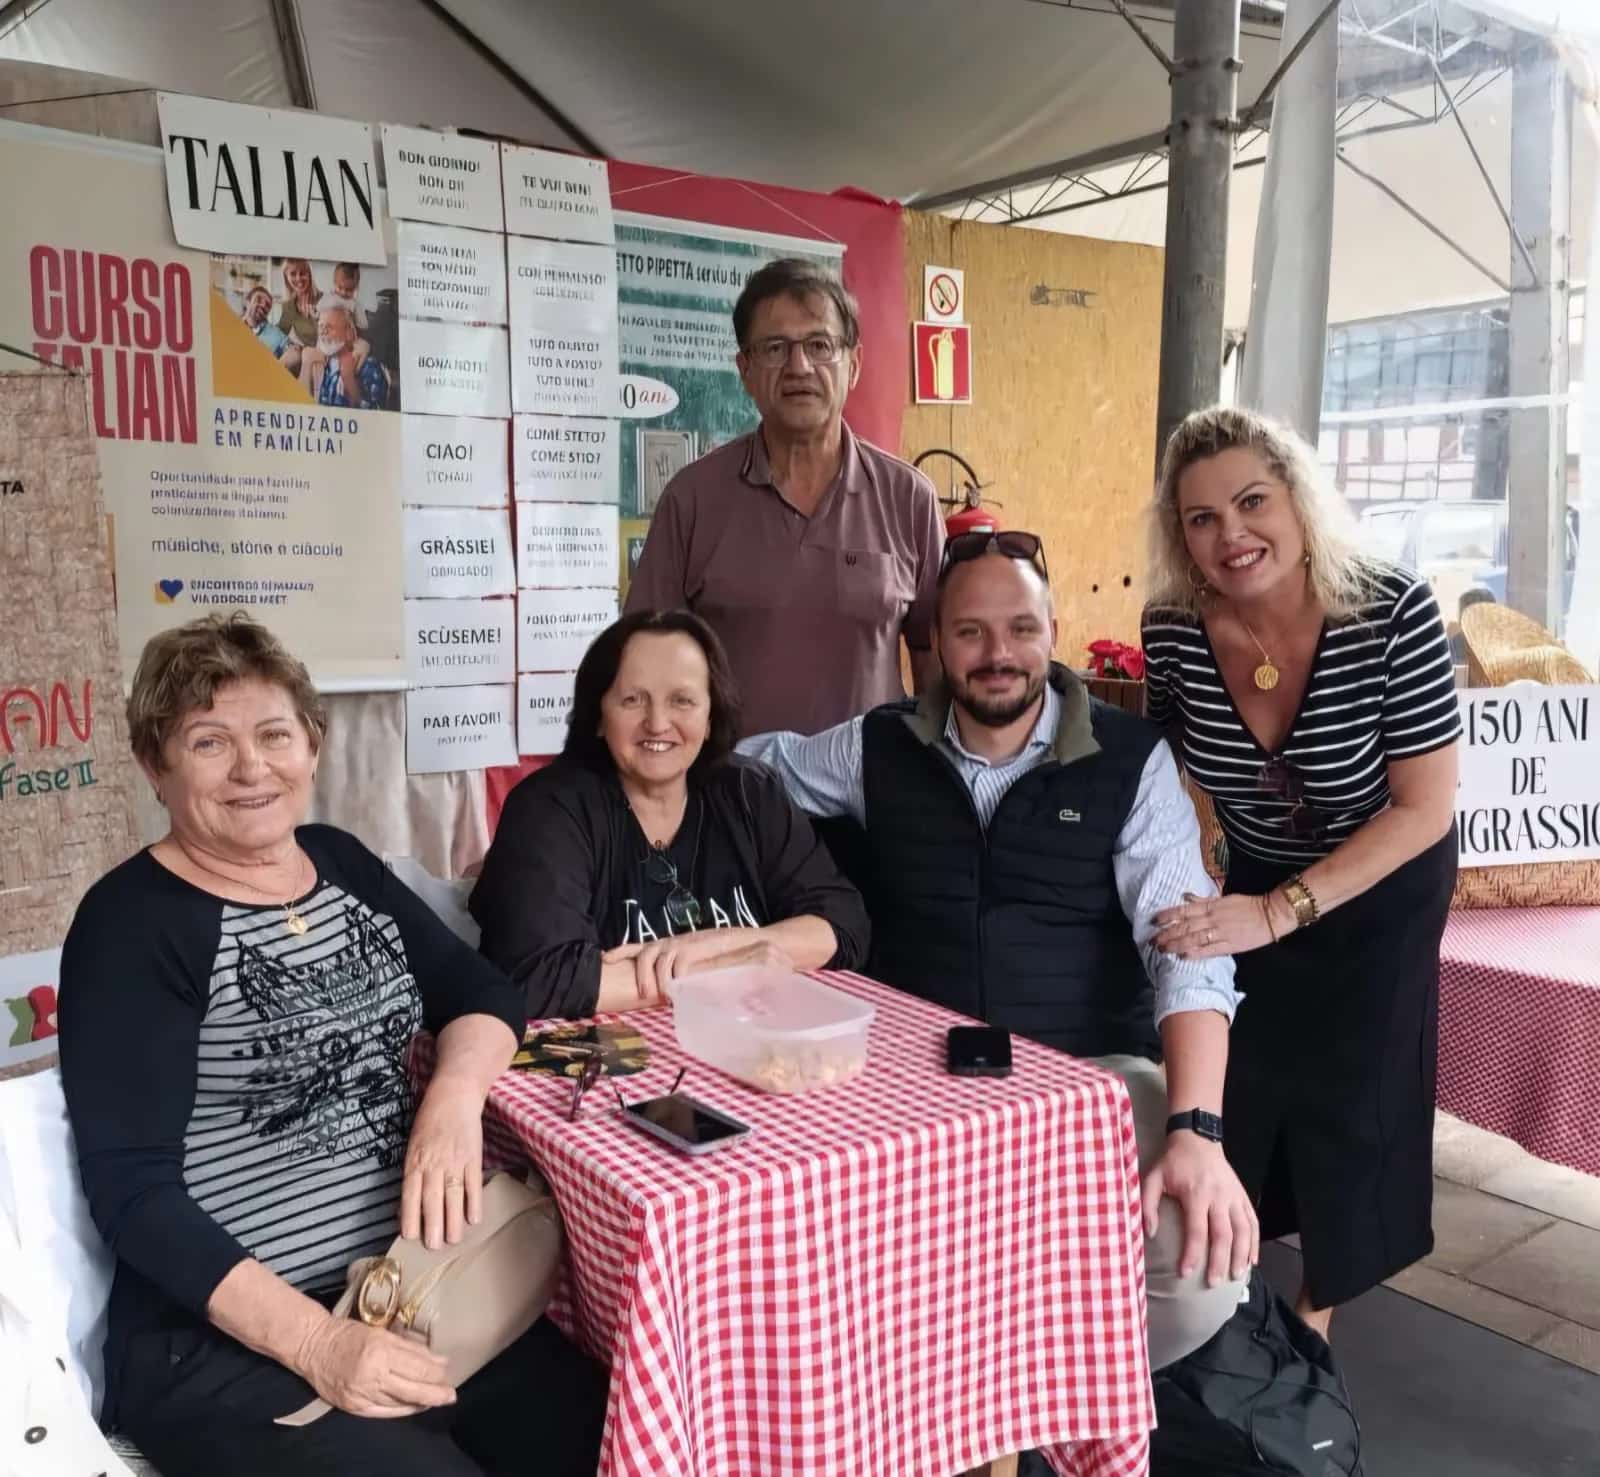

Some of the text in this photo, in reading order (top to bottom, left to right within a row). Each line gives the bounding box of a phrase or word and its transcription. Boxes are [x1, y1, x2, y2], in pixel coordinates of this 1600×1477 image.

[168, 134, 375, 230] TALIAN
[647, 256, 693, 281] PIPETTA
[30, 244, 194, 354] CURSO
[214, 408, 359, 434] APRENDIZADO
[215, 430, 242, 448] EM
[426, 443, 473, 461] CIAO!
[420, 535, 495, 555] GRÀSSIE!
[0, 679, 93, 753] AN
[1468, 697, 1589, 746] 150 ANI
[0, 762, 71, 799] fase
[1511, 756, 1547, 796] DE
